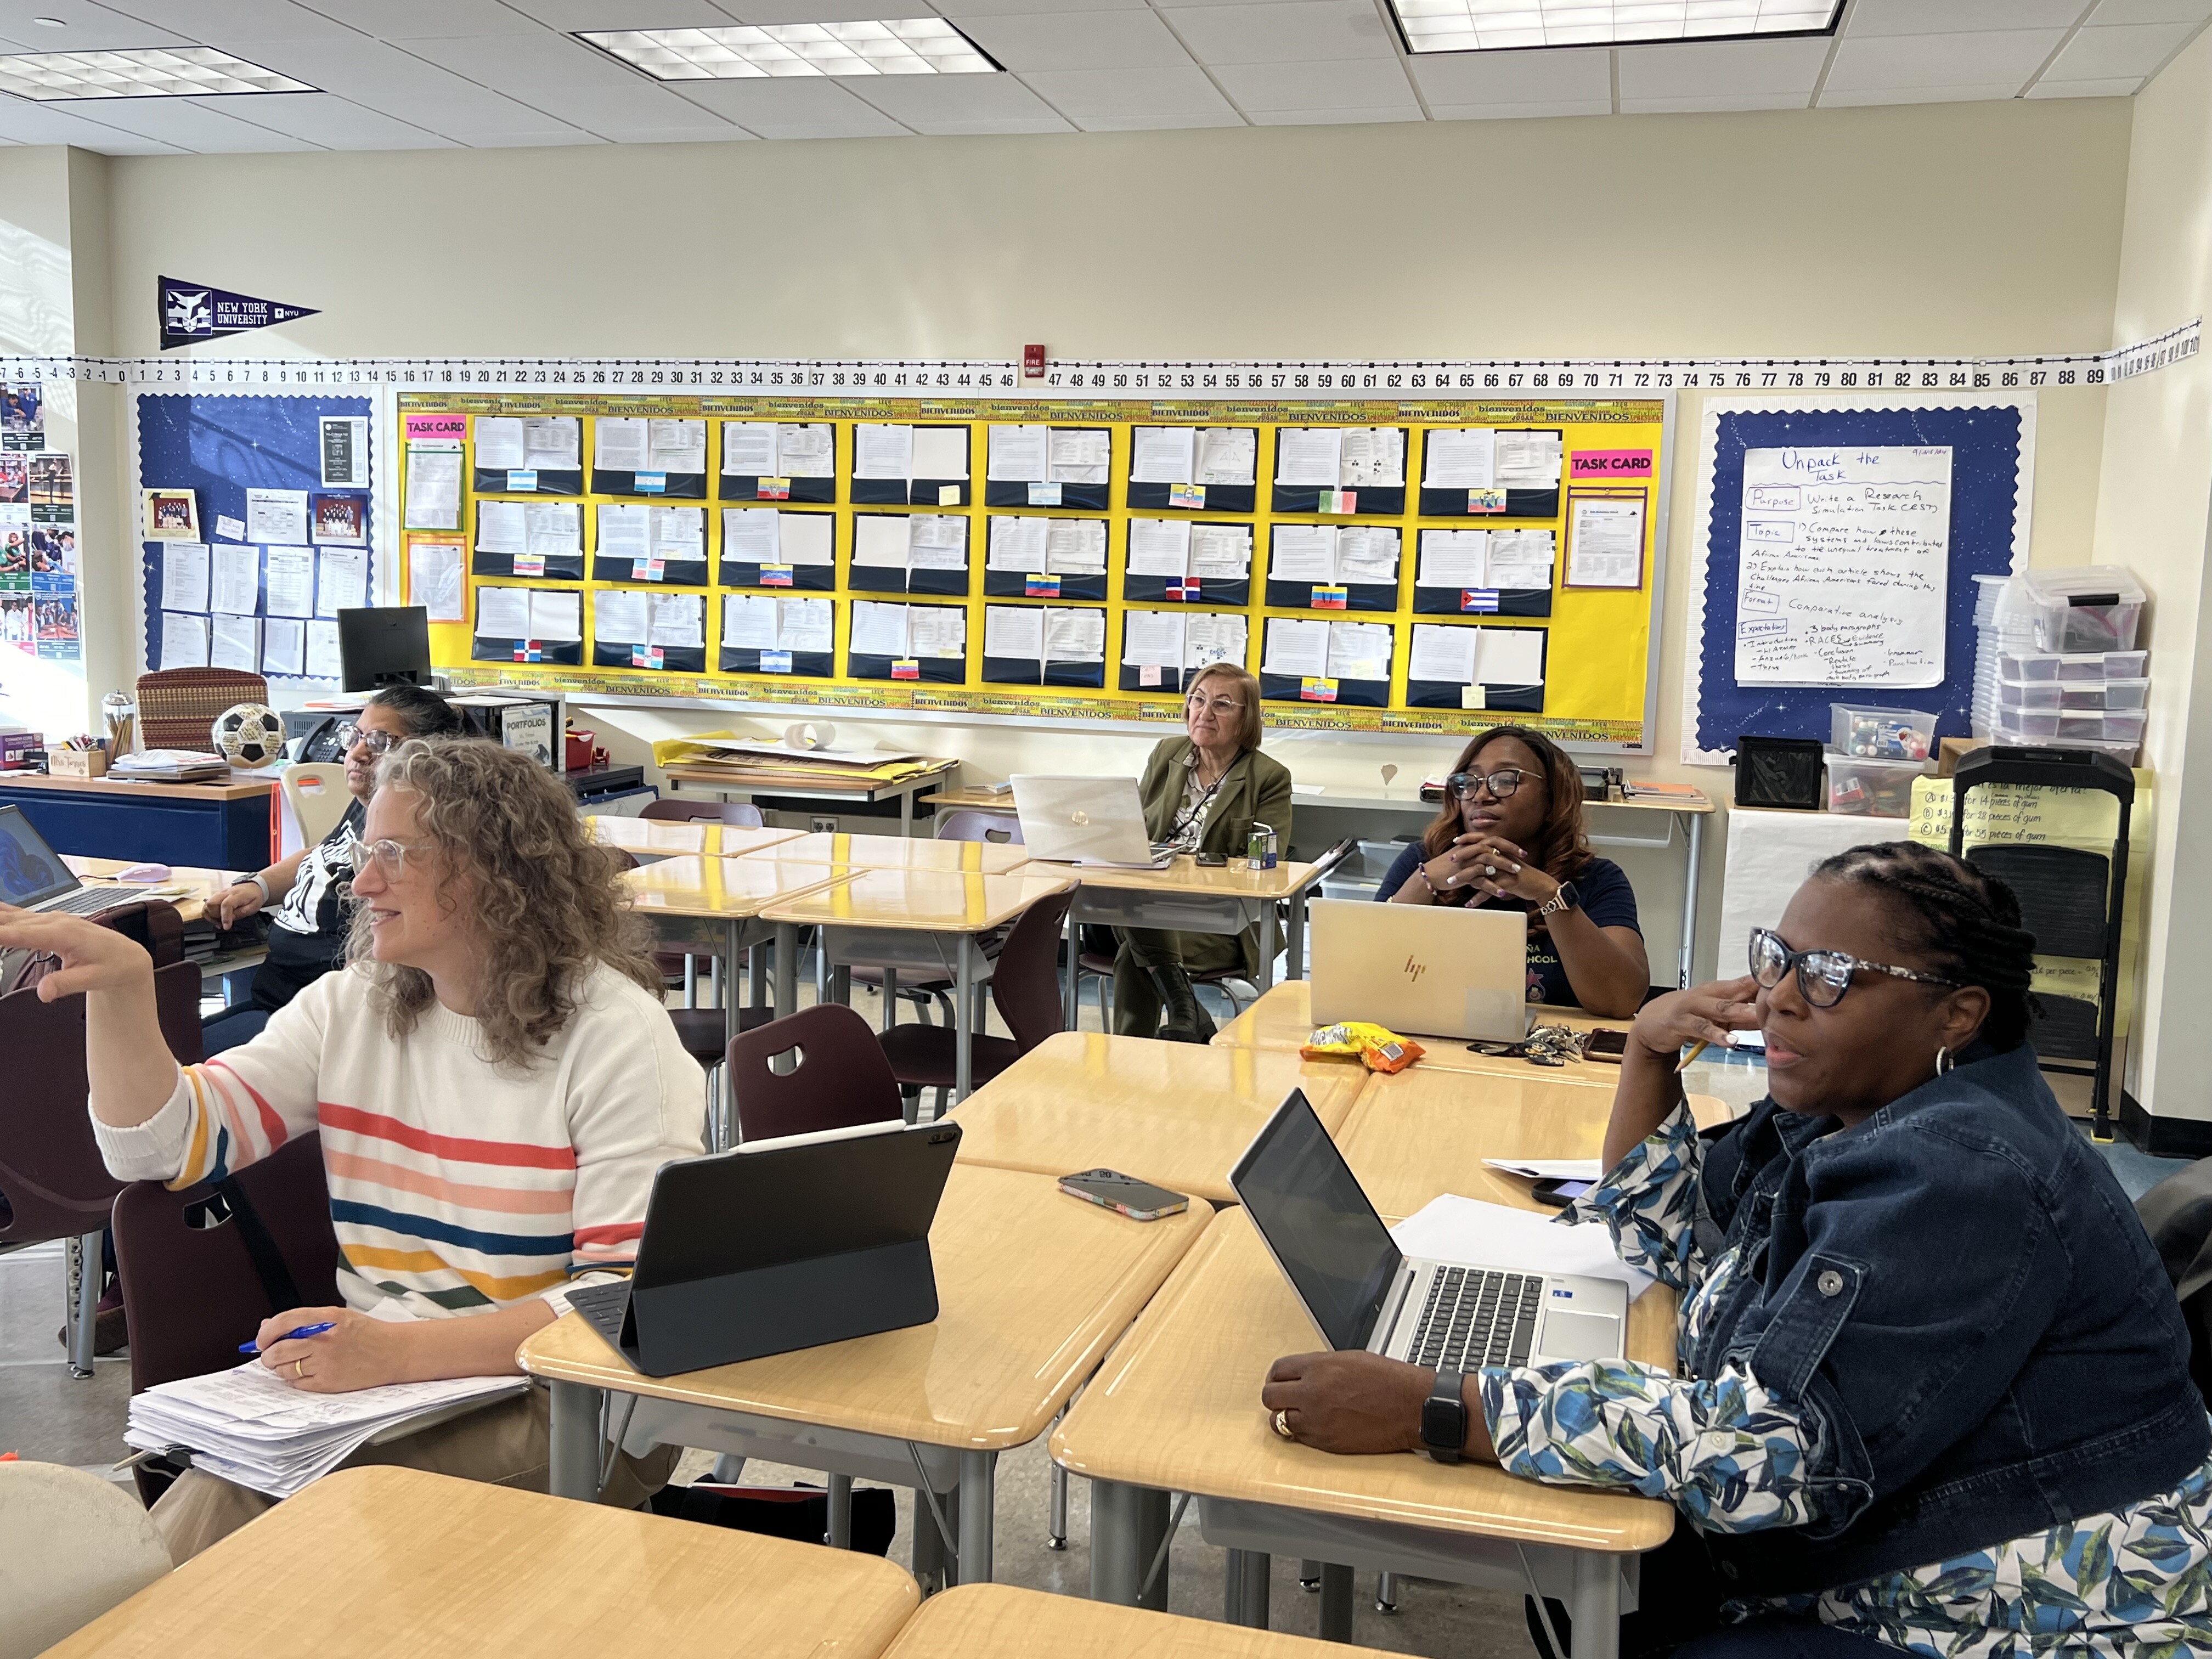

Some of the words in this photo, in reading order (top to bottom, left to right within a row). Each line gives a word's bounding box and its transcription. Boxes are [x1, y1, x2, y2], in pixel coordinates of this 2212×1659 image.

[217, 302, 240, 313] NEW
[242, 302, 268, 313] YORK
[217, 314, 268, 325] UNIVERSITY
[139, 369, 145, 381] 1
[157, 370, 163, 381] 2
[174, 369, 180, 381] 3
[193, 370, 198, 381] 4
[210, 370, 215, 381] 5
[227, 370, 233, 381] 6
[244, 370, 250, 381] 7
[262, 371, 268, 382] 8
[280, 371, 286, 382] 9
[296, 371, 307, 382] 10
[314, 371, 323, 382] 11
[331, 371, 343, 382] 12
[349, 370, 360, 382] 13
[367, 370, 378, 382] 14
[386, 370, 397, 382] 15
[404, 370, 415, 382] 16
[422, 370, 433, 382] 17
[441, 370, 452, 382] 18
[459, 370, 471, 382] 19
[478, 370, 489, 382] 20
[496, 370, 506, 382] 21
[515, 370, 527, 382] 22
[534, 371, 546, 383] 23
[553, 371, 566, 383] 24
[573, 371, 585, 383] 25
[592, 371, 605, 383] 26
[612, 371, 624, 383] 27
[631, 371, 644, 383] 28
[651, 371, 663, 383] 29
[670, 371, 683, 383] 30
[690, 371, 702, 383] 31
[710, 371, 723, 383] 32
[730, 371, 743, 384] 33
[751, 372, 763, 384] 34
[771, 372, 783, 385] 35
[791, 373, 803, 385] 36
[812, 373, 825, 385] 37
[832, 373, 845, 385] 38
[853, 373, 866, 385] 39
[873, 373, 887, 385] 40
[894, 373, 906, 385] 41
[916, 373, 928, 386] 42
[936, 373, 949, 386] 43
[957, 374, 971, 386] 44
[979, 374, 992, 386] 45
[1000, 374, 1013, 387] 46
[1048, 373, 1062, 386] 47
[1070, 374, 1084, 387] 48
[1091, 374, 1105, 387] 49
[1114, 374, 1127, 387] 50
[1136, 374, 1148, 387] 51
[1158, 374, 1172, 387] 52
[1181, 374, 1194, 387] 53
[1203, 374, 1217, 387] 54
[1225, 374, 1240, 387] 55
[1248, 374, 1262, 387] 56
[1271, 374, 1286, 387] 57
[1294, 374, 1309, 387] 58
[1317, 374, 1332, 387] 59
[1341, 374, 1356, 388] 60
[1363, 374, 1376, 387] 61
[1387, 374, 1402, 387] 62
[1412, 374, 1426, 387] 63
[1435, 374, 1450, 387] 64
[1459, 374, 1474, 387] 65
[1484, 374, 1499, 387] 66
[1509, 374, 1524, 387] 67
[1533, 373, 1548, 387] 68
[1558, 373, 1573, 387] 69
[1583, 373, 1599, 387] 70
[1609, 373, 1622, 387] 71
[1634, 373, 1649, 387] 72
[1657, 373, 1673, 387] 73
[1683, 373, 1699, 387] 74
[1709, 373, 1724, 387] 75
[1735, 373, 1751, 386] 76
[1761, 373, 1778, 386] 77
[1787, 373, 1803, 386] 78
[1814, 373, 1830, 386] 79
[1841, 373, 1857, 386] 80
[1867, 372, 1882, 386] 81
[1894, 373, 1911, 387] 82
[1921, 373, 1938, 386] 83
[1949, 373, 1966, 386] 84
[1973, 373, 1990, 387] 85
[2001, 372, 2018, 387] 86
[2030, 371, 2047, 386] 87
[2058, 370, 2075, 385] 88
[2086, 369, 2104, 383] 89
[608, 406, 674, 414] BIENVENIDOS
[824, 409, 894, 417] BIENVENIDOS
[1289, 413, 1367, 421] BIENVENIDOS
[1546, 413, 1629, 421] BIENVENIDOS
[407, 422, 433, 432] TASK
[436, 422, 465, 432] CARD
[1572, 458, 1608, 470] TASK
[1611, 458, 1651, 470] CARD
[1782, 450, 1840, 472] Unpack
[1857, 452, 1880, 465] the
[1809, 469, 1846, 482] Task
[1753, 489, 1794, 508] Purpose
[1808, 494, 1839, 504] Write
[1865, 487, 1921, 500] Research
[1867, 503, 1897, 511] Task
[1750, 524, 1780, 538] Topic
[1809, 522, 1849, 534] Compare
[1857, 526, 1876, 534] how
[1890, 526, 1917, 537] these
[1838, 568, 1867, 576] article
[1788, 598, 1852, 617] Comparative
[554, 677, 606, 685] bienvenidos
[606, 686, 671, 695] BIENVENIDOS
[763, 687, 818, 696] bienvenidos
[818, 696, 886, 706] BIENVENIDOS
[915, 698, 968, 707] BIENVENIDOS
[983, 698, 1040, 707] bienvenidos
[1040, 708, 1112, 718] BIENVENIDOS
[507, 718, 546, 730] PORTFOLIOS
[1275, 718, 1352, 729] BIENVENIDOS
[1383, 720, 1442, 729] BIENVENIDOS
[1963, 794, 1976, 806] for
[2012, 797, 2022, 808] of
[2021, 799, 2038, 810] gum
[1527, 955, 1558, 963] HOOL
